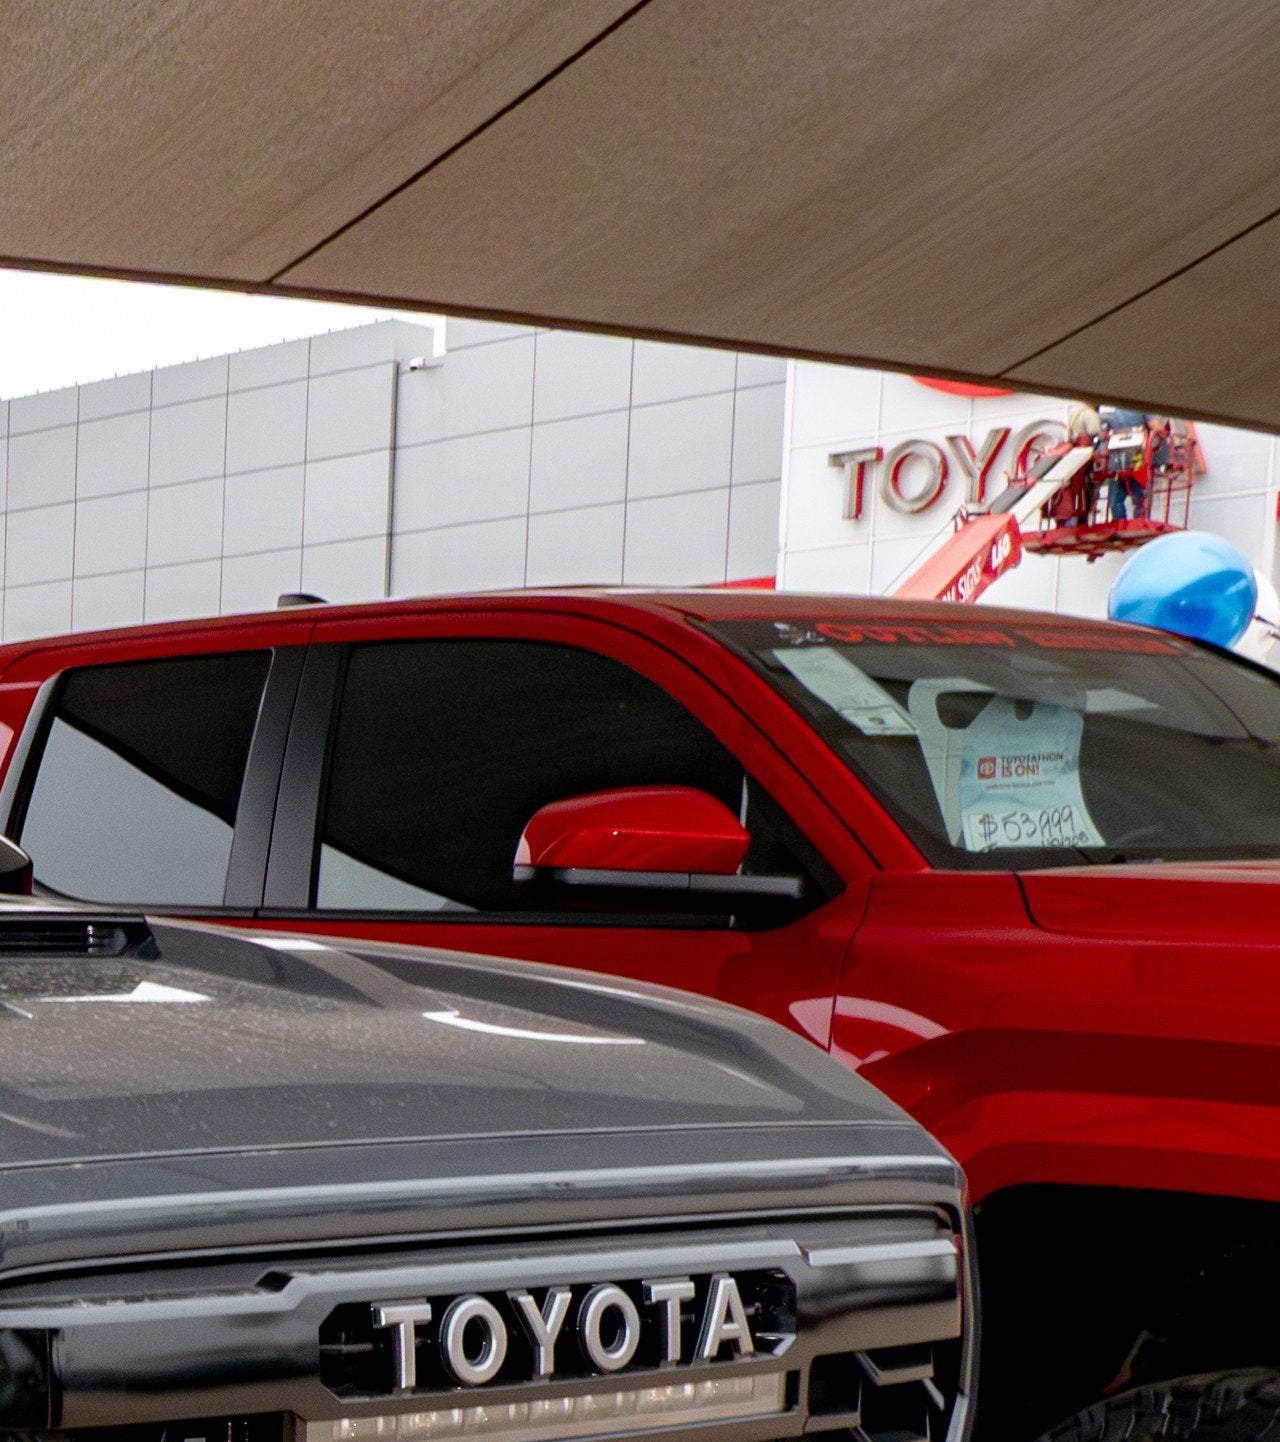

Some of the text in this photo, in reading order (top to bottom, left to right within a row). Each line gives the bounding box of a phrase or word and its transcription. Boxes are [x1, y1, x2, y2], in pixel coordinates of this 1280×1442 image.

[1001, 753, 1063, 764] TOYOTATHON
[1001, 763, 1040, 778] IS ON!
[371, 1273, 755, 1389] TOYOTA
